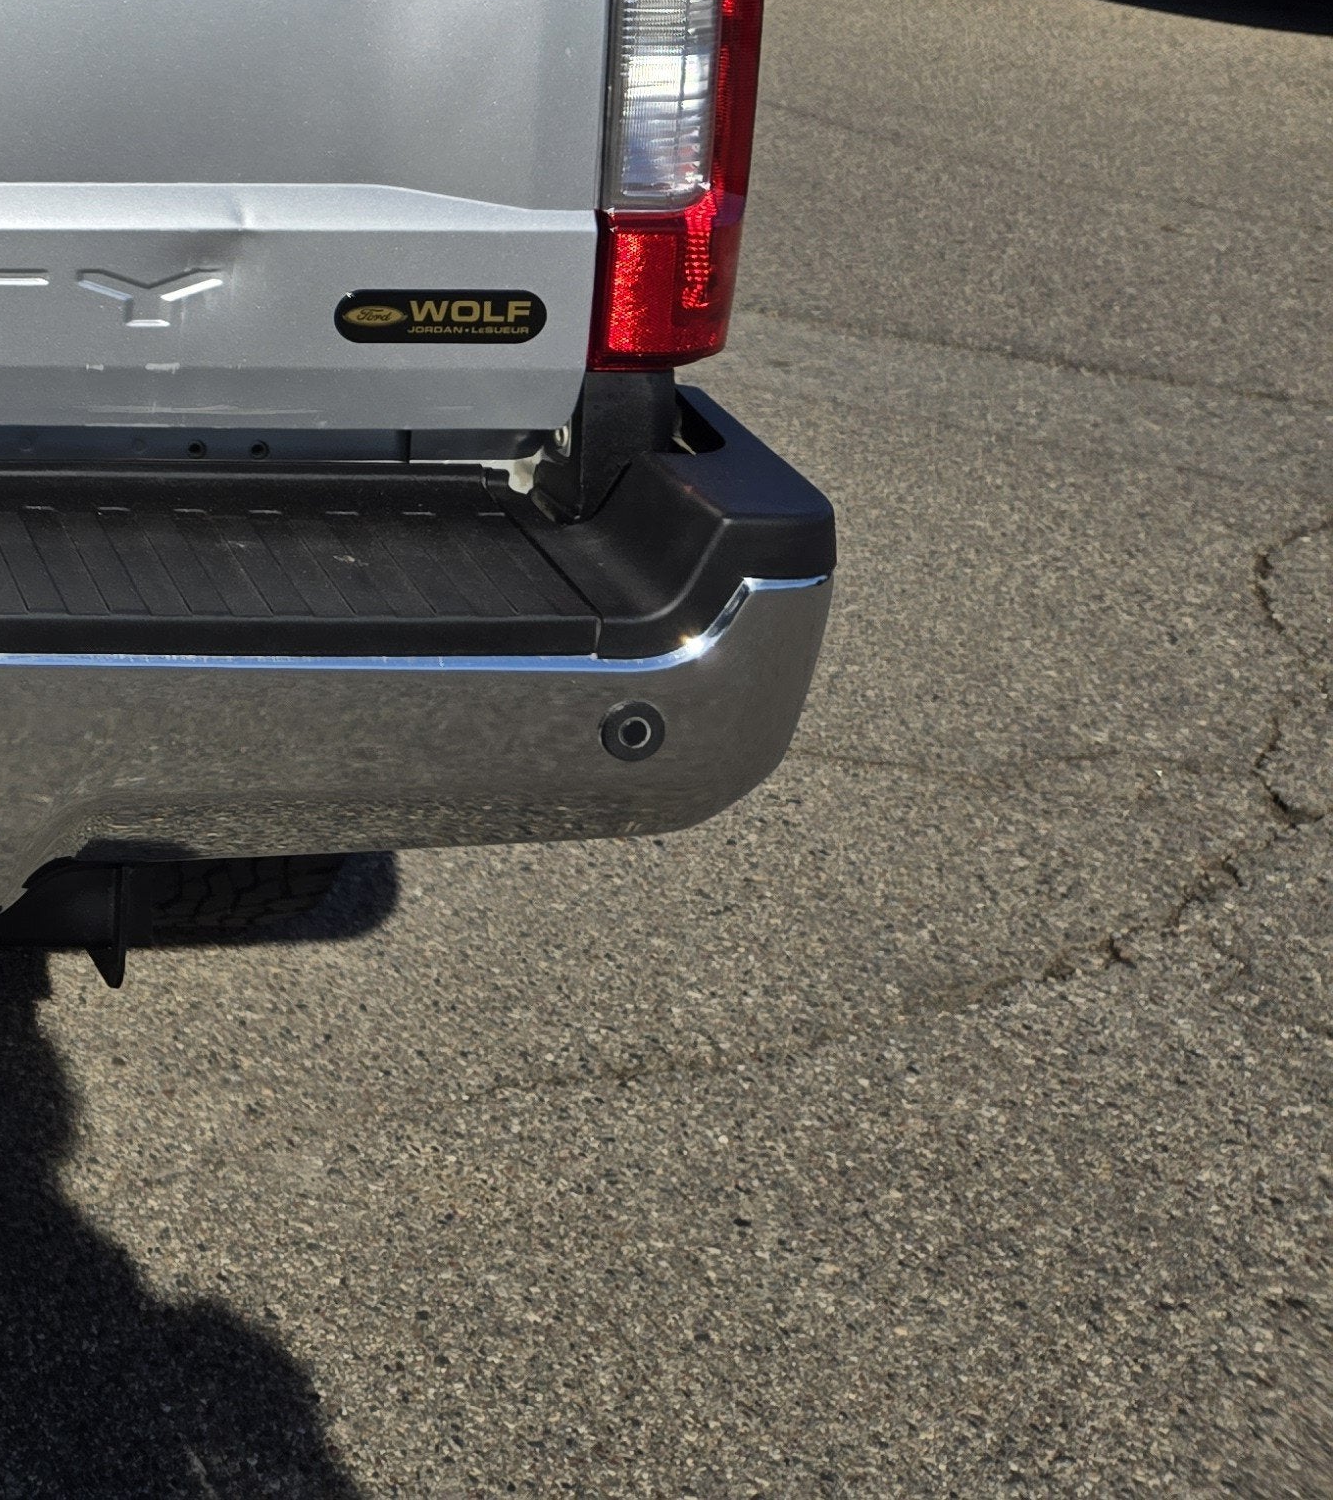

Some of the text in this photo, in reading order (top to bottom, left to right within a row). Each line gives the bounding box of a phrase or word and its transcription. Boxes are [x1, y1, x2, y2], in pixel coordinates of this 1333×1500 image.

[356, 309, 393, 321] Ford
[409, 300, 532, 323] WOLF
[406, 326, 463, 334] JORDAN
